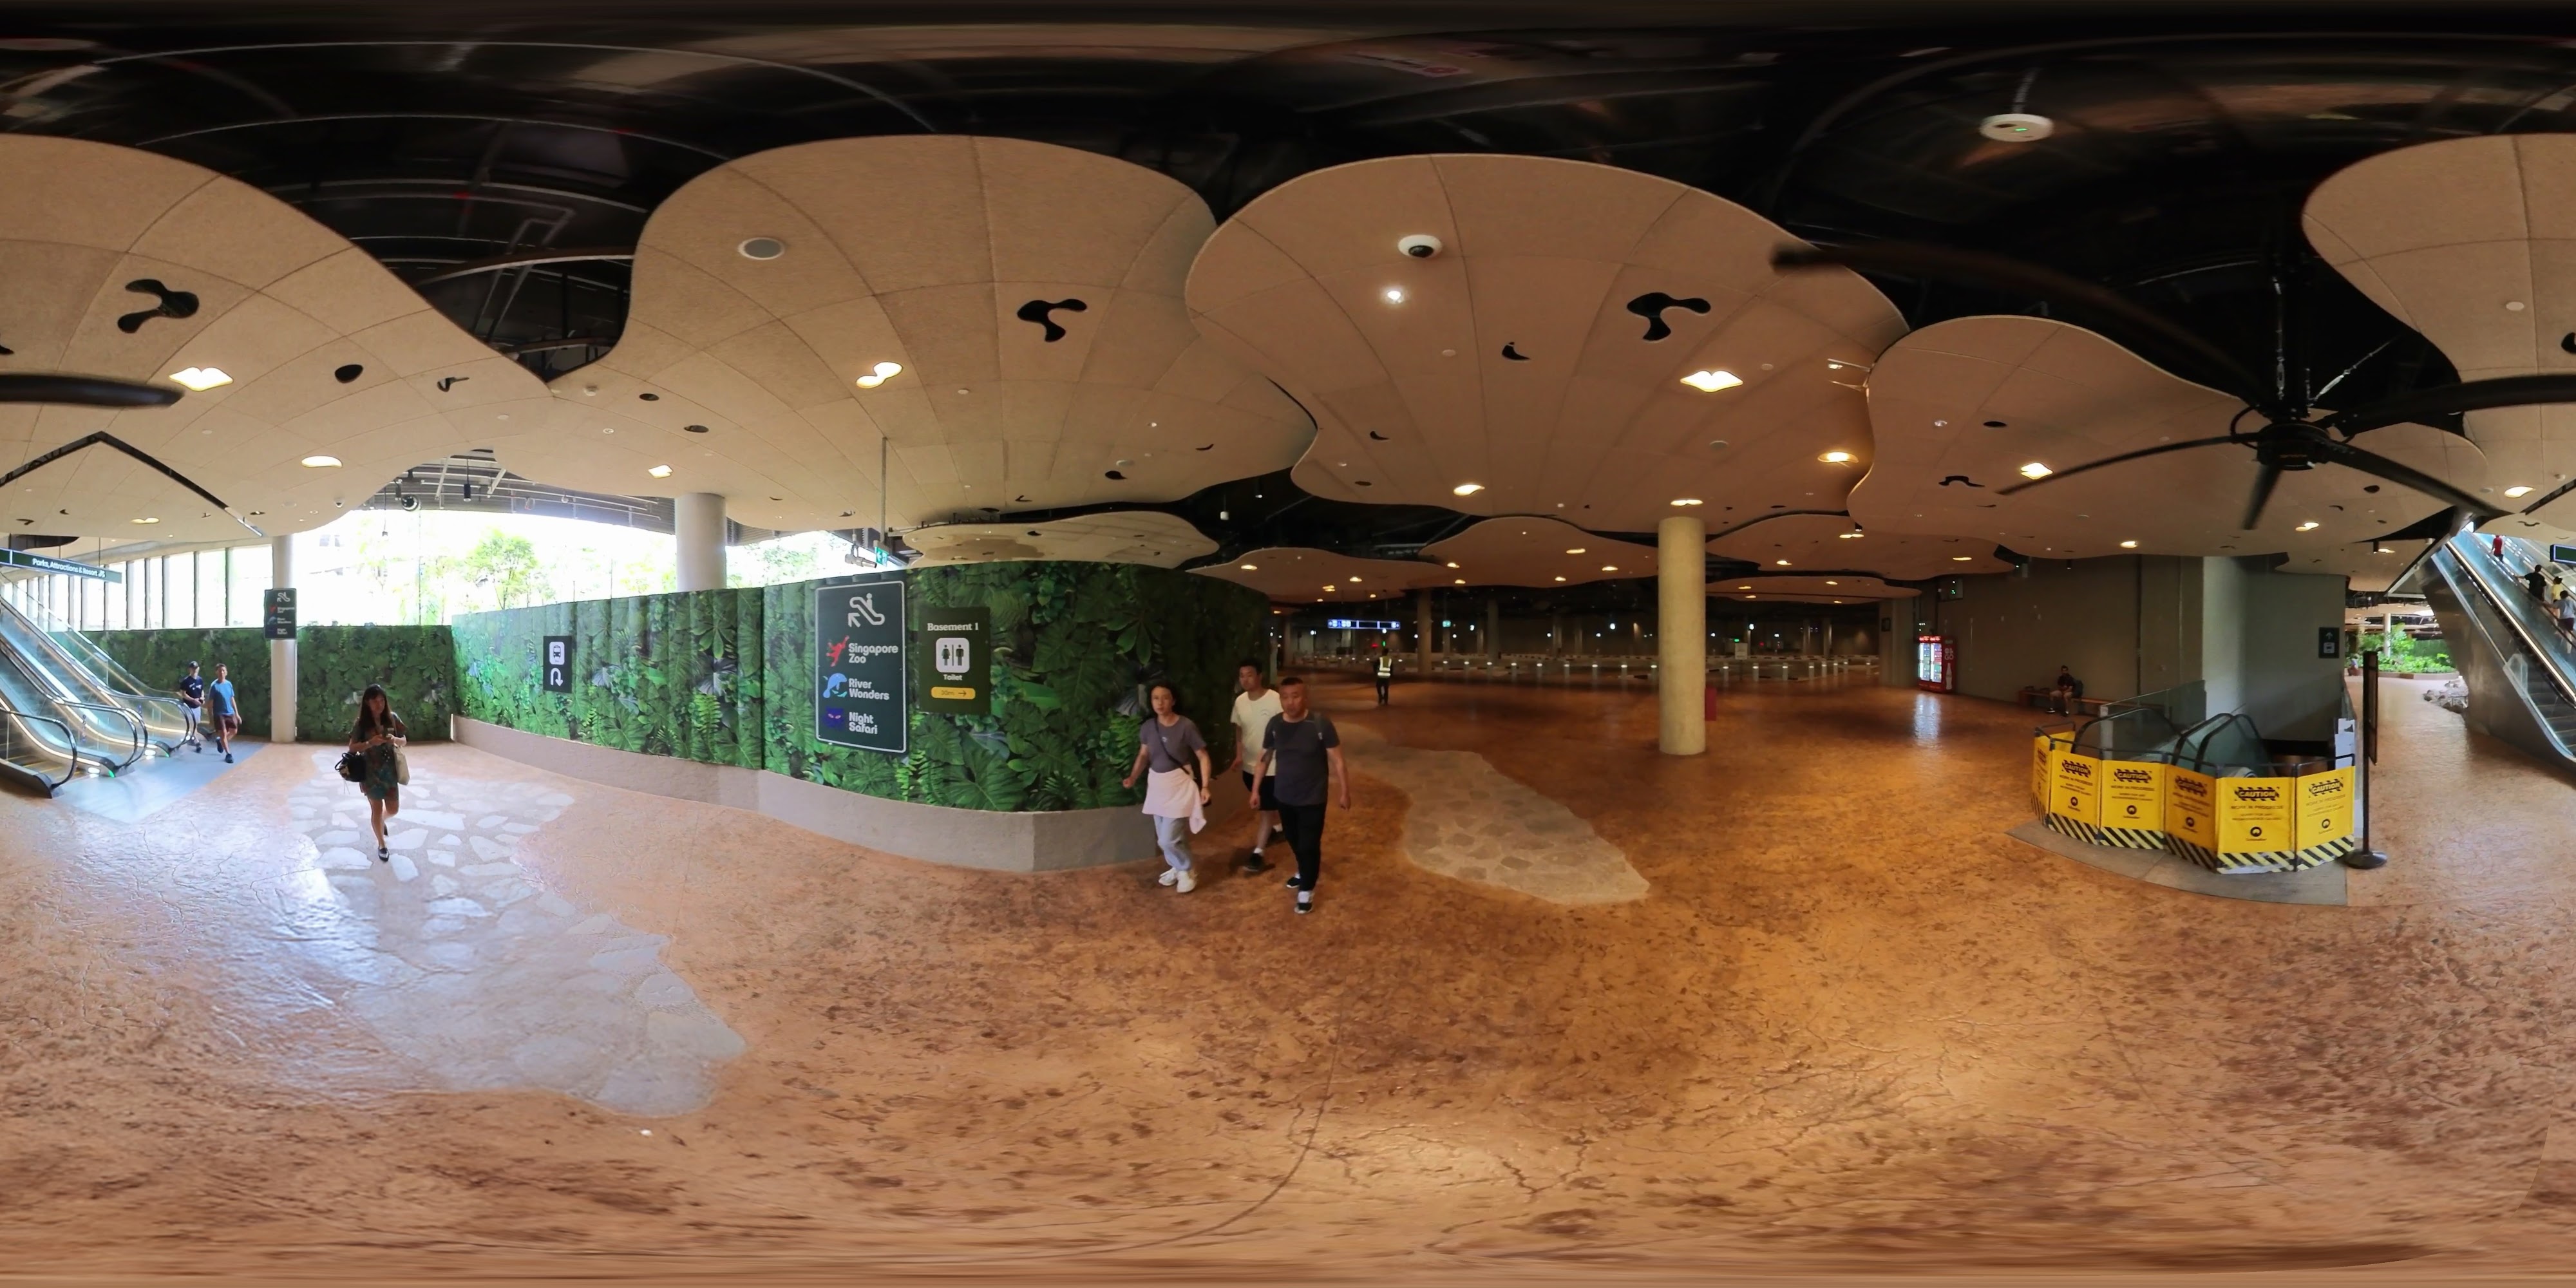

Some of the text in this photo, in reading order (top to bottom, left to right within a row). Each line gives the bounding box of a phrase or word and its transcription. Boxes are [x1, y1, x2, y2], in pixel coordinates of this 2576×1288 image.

[32, 558, 50, 568] Parks,
[50, 562, 78, 572] Attractions
[927, 623, 972, 631] Basement
[848, 643, 898, 656] Singapore
[848, 653, 866, 664] Zoo
[848, 678, 872, 689] River
[848, 688, 889, 701] Wonders
[849, 712, 874, 726] Night
[849, 721, 878, 735] Safari
[2065, 764, 2088, 773] CAUTION
[2312, 782, 2340, 793] CAUTION
